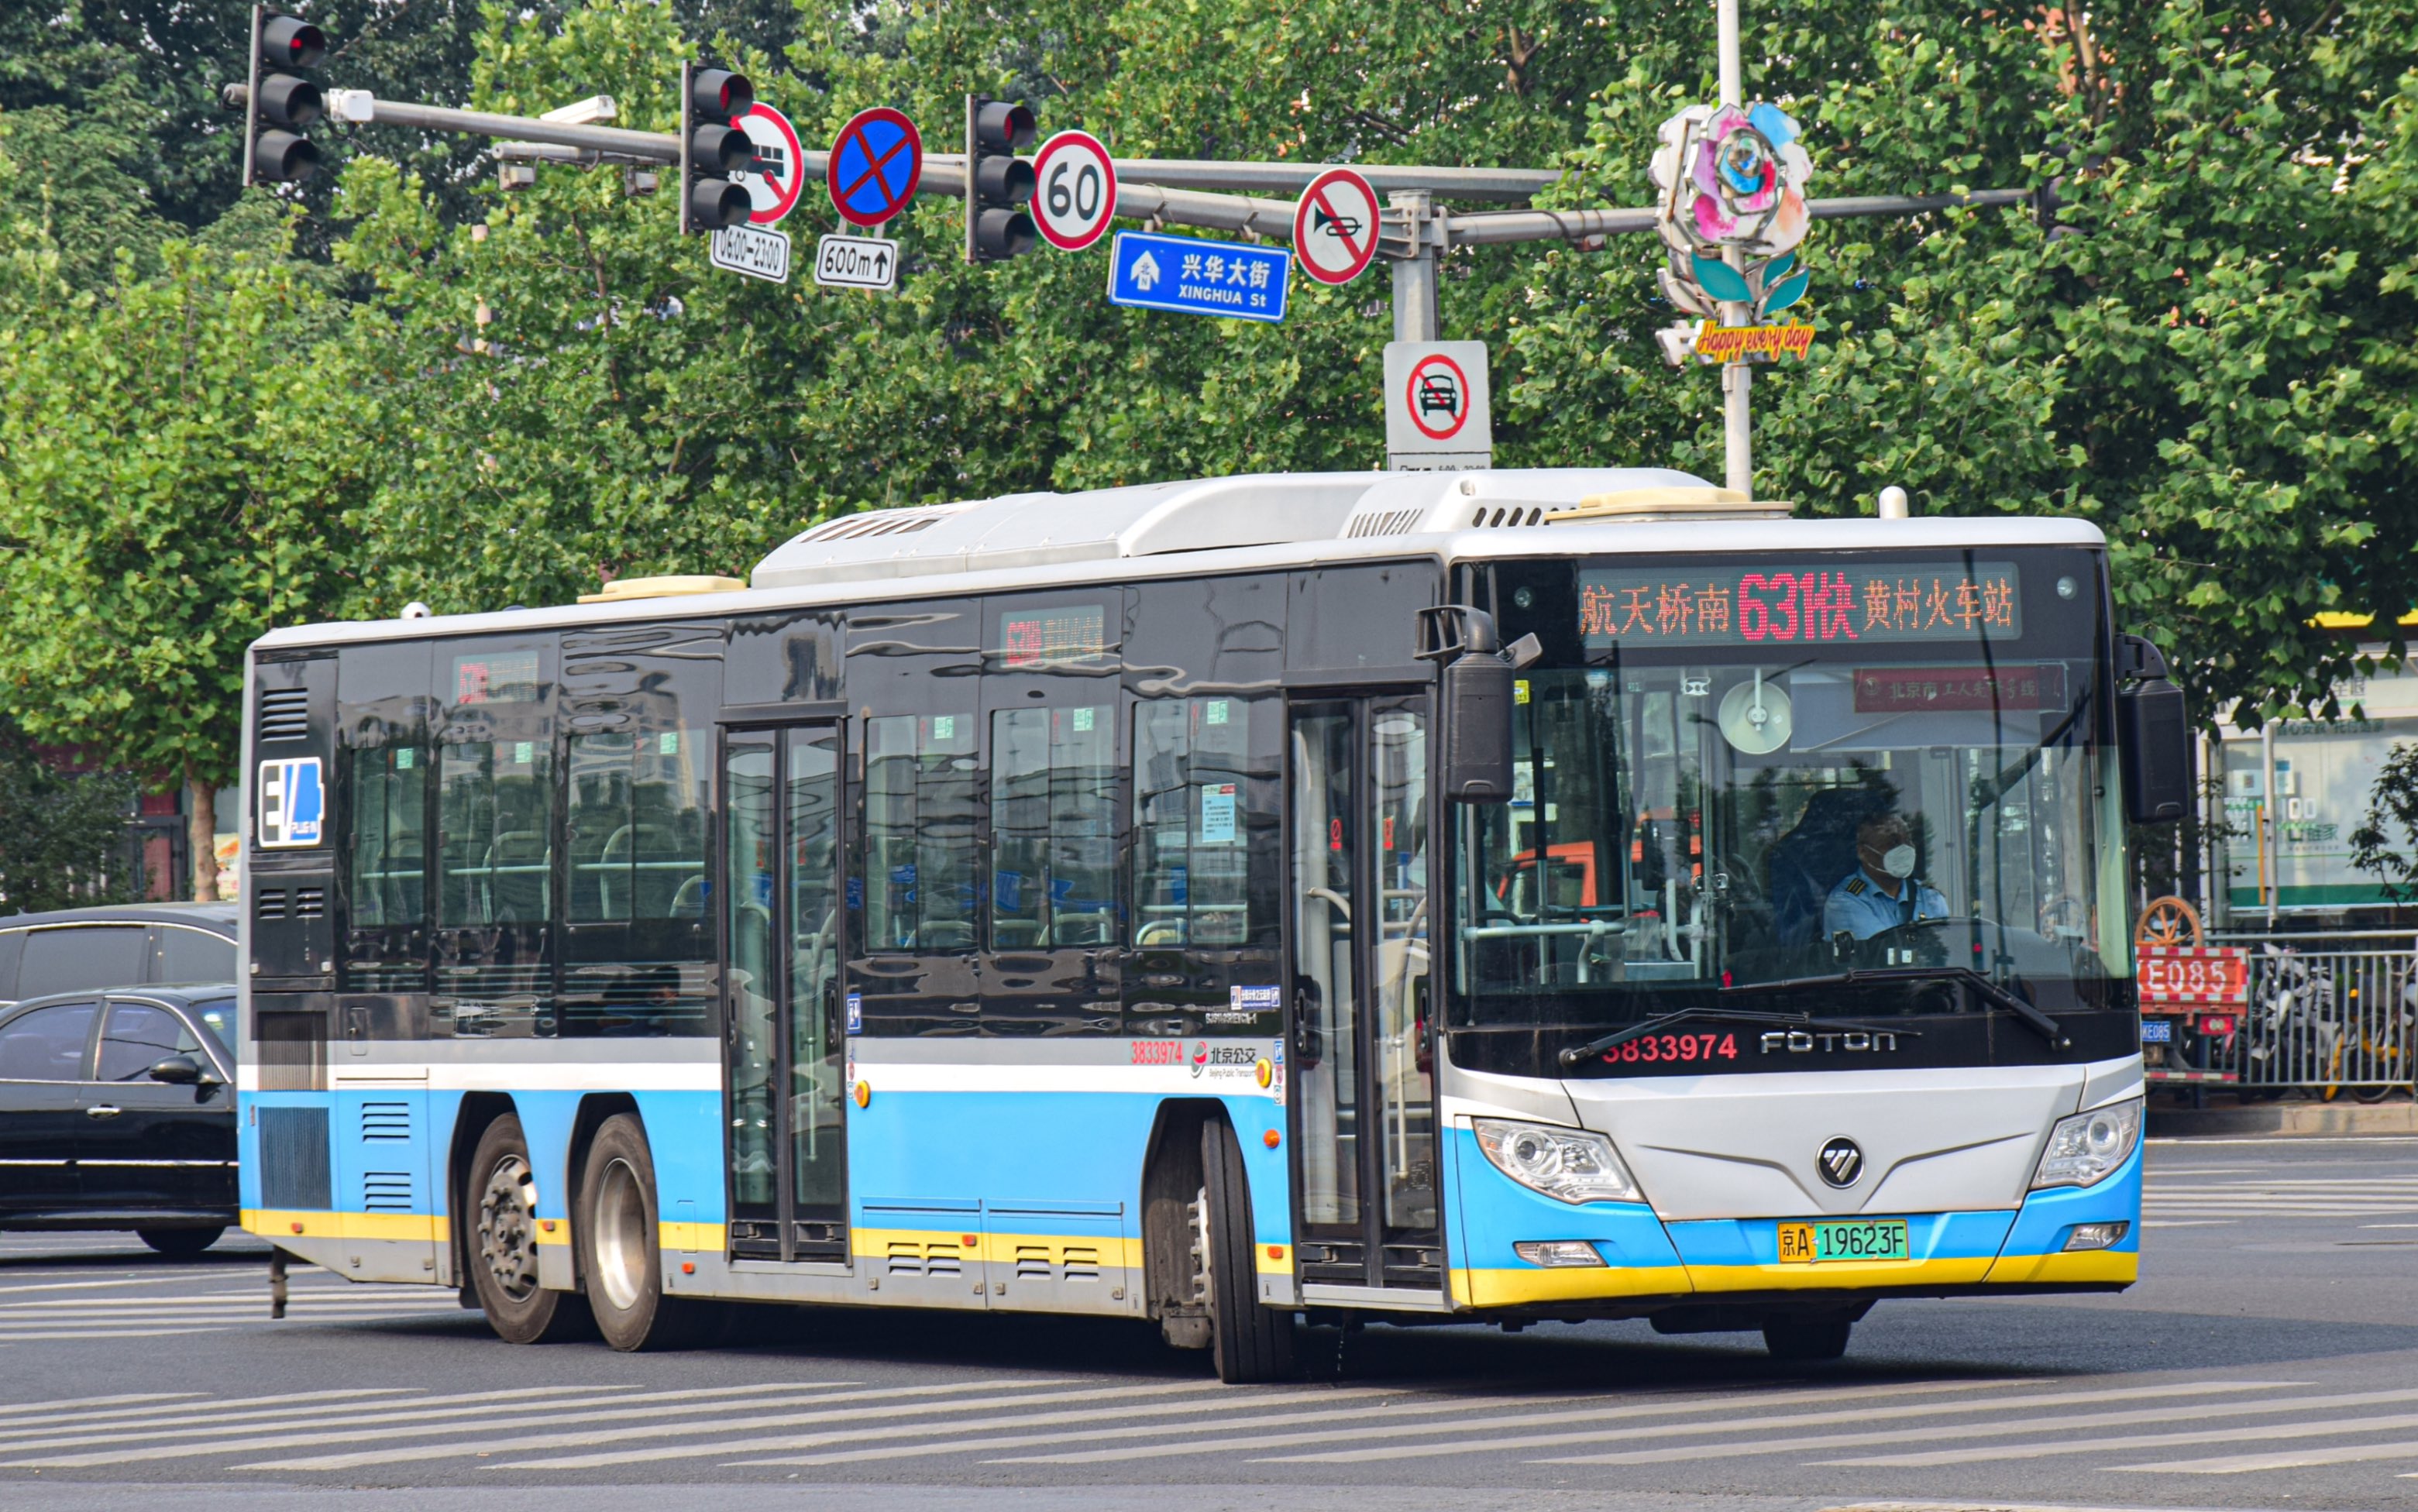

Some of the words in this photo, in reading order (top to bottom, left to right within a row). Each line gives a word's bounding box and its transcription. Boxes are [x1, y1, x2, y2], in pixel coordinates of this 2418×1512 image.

[1047, 161, 1099, 221] 60
[825, 246, 870, 277] 600m
[1181, 253, 1271, 289] 兴华大街
[1178, 284, 1243, 304] XINGHUA
[1250, 294, 1267, 307] St
[1697, 320, 1743, 362] Happy
[1746, 325, 1781, 360] every
[1784, 318, 1812, 359] day
[1580, 582, 1730, 635] 航天桥南
[1738, 572, 1859, 641] 631快
[1863, 578, 2014, 631] 黄村火车站
[1131, 1041, 1184, 1065] 3833974
[1211, 1047, 1257, 1064] 北京公交
[1602, 1033, 1738, 1064] 3833974
[1760, 1031, 1897, 1054] FOTON
[1782, 1226, 1810, 1256] 京A
[1822, 1225, 1905, 1256] 19623F
